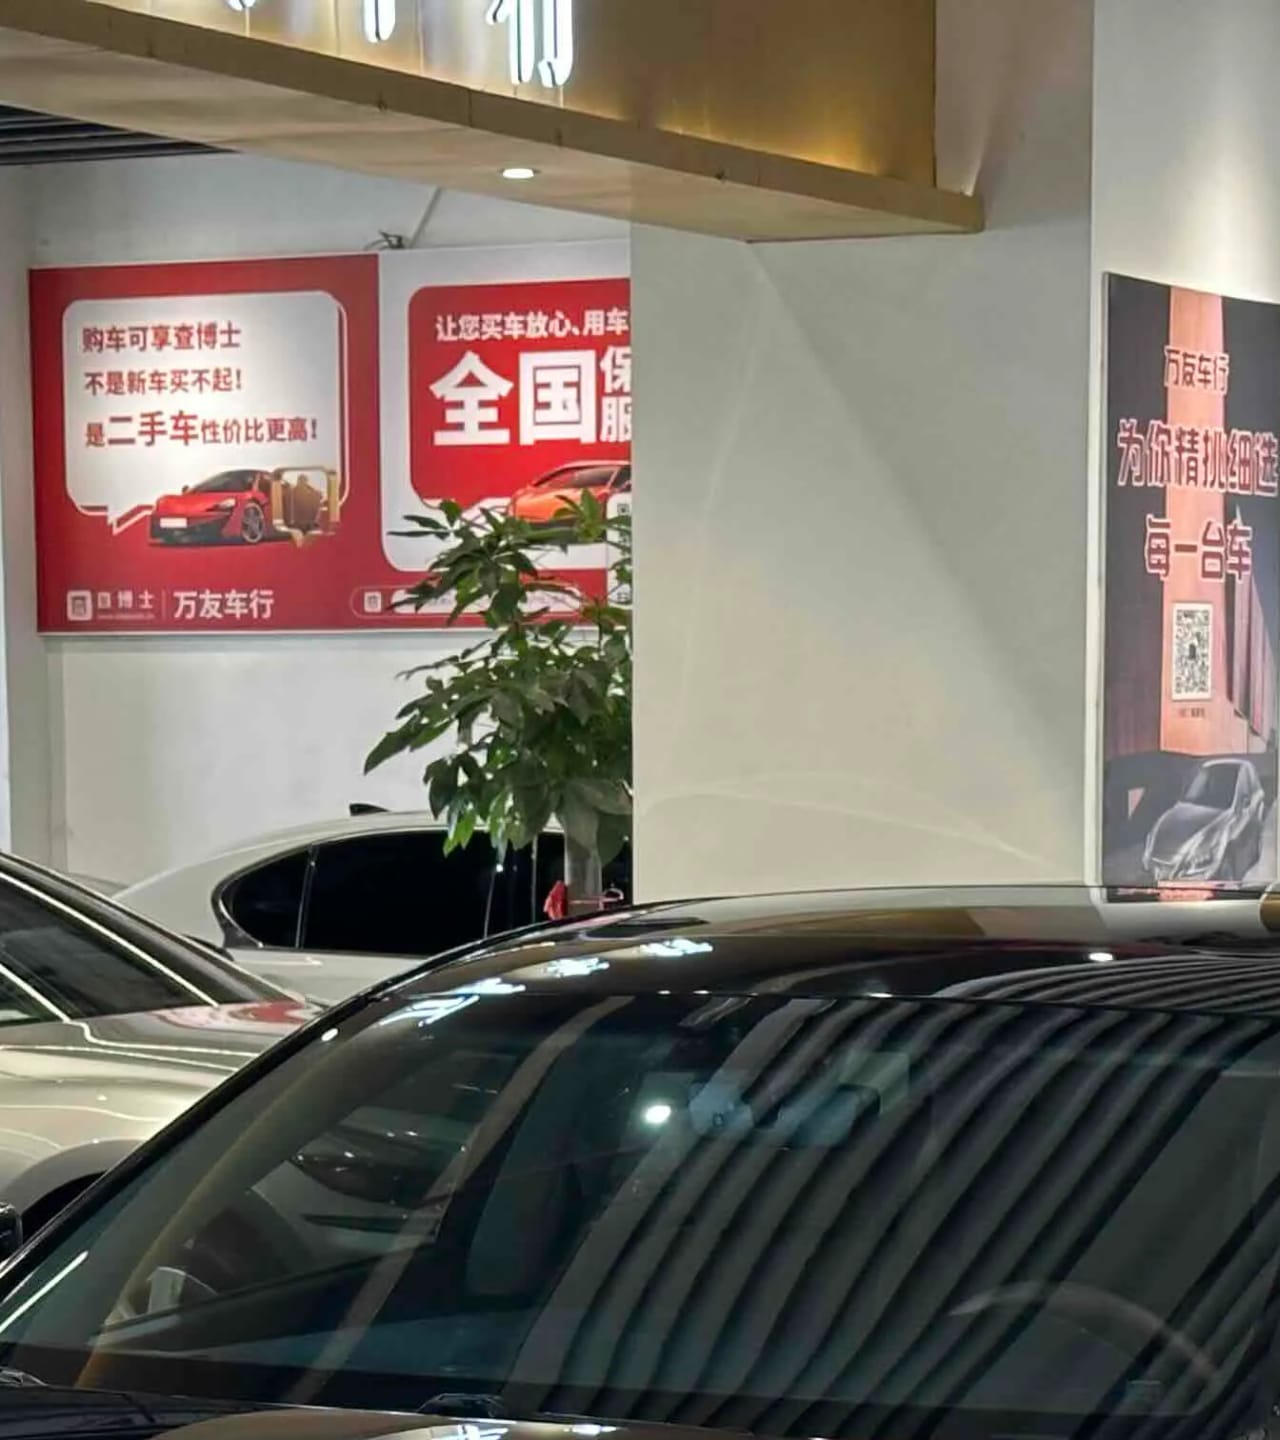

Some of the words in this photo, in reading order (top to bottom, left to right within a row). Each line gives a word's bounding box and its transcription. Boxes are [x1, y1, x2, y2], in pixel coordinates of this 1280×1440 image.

[81, 321, 242, 353] 购车可享查博士
[435, 306, 630, 342] 让您买车放心、用车
[84, 366, 243, 397] 不是新车买不起！
[1164, 346, 1230, 396] 万友车行
[428, 349, 598, 446] 全国
[84, 409, 319, 448] 是二手车性价比更高！
[1117, 418, 1280, 497] 为你精挑细选
[1144, 513, 1252, 583] 每一台车
[172, 587, 275, 620] 万友车行
